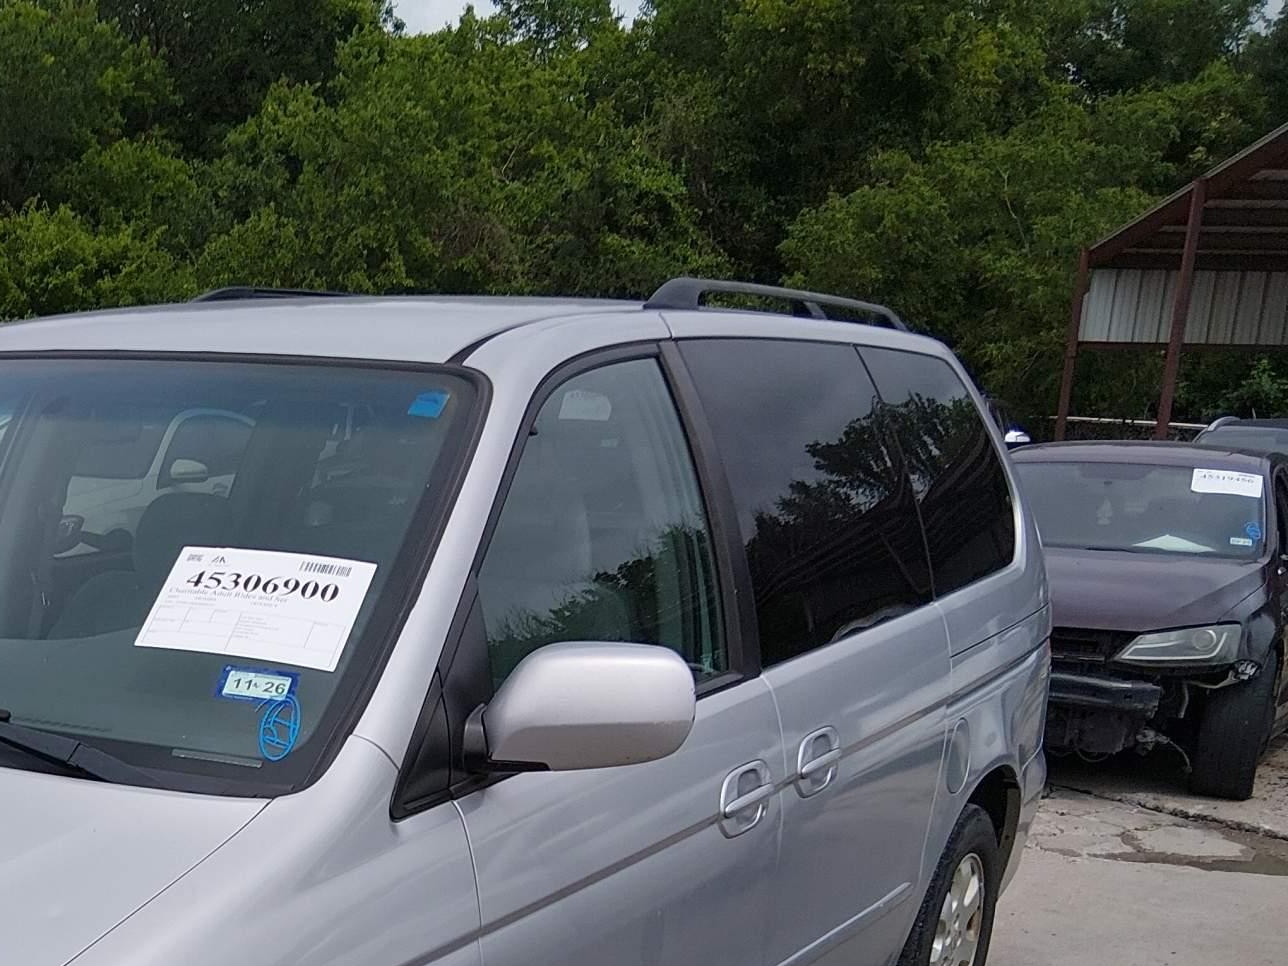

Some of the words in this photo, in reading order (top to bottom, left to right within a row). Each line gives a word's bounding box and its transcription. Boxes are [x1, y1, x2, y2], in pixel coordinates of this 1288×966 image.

[186, 570, 339, 602] 45306900
[233, 678, 253, 691] 11
[262, 681, 287, 695] 26
